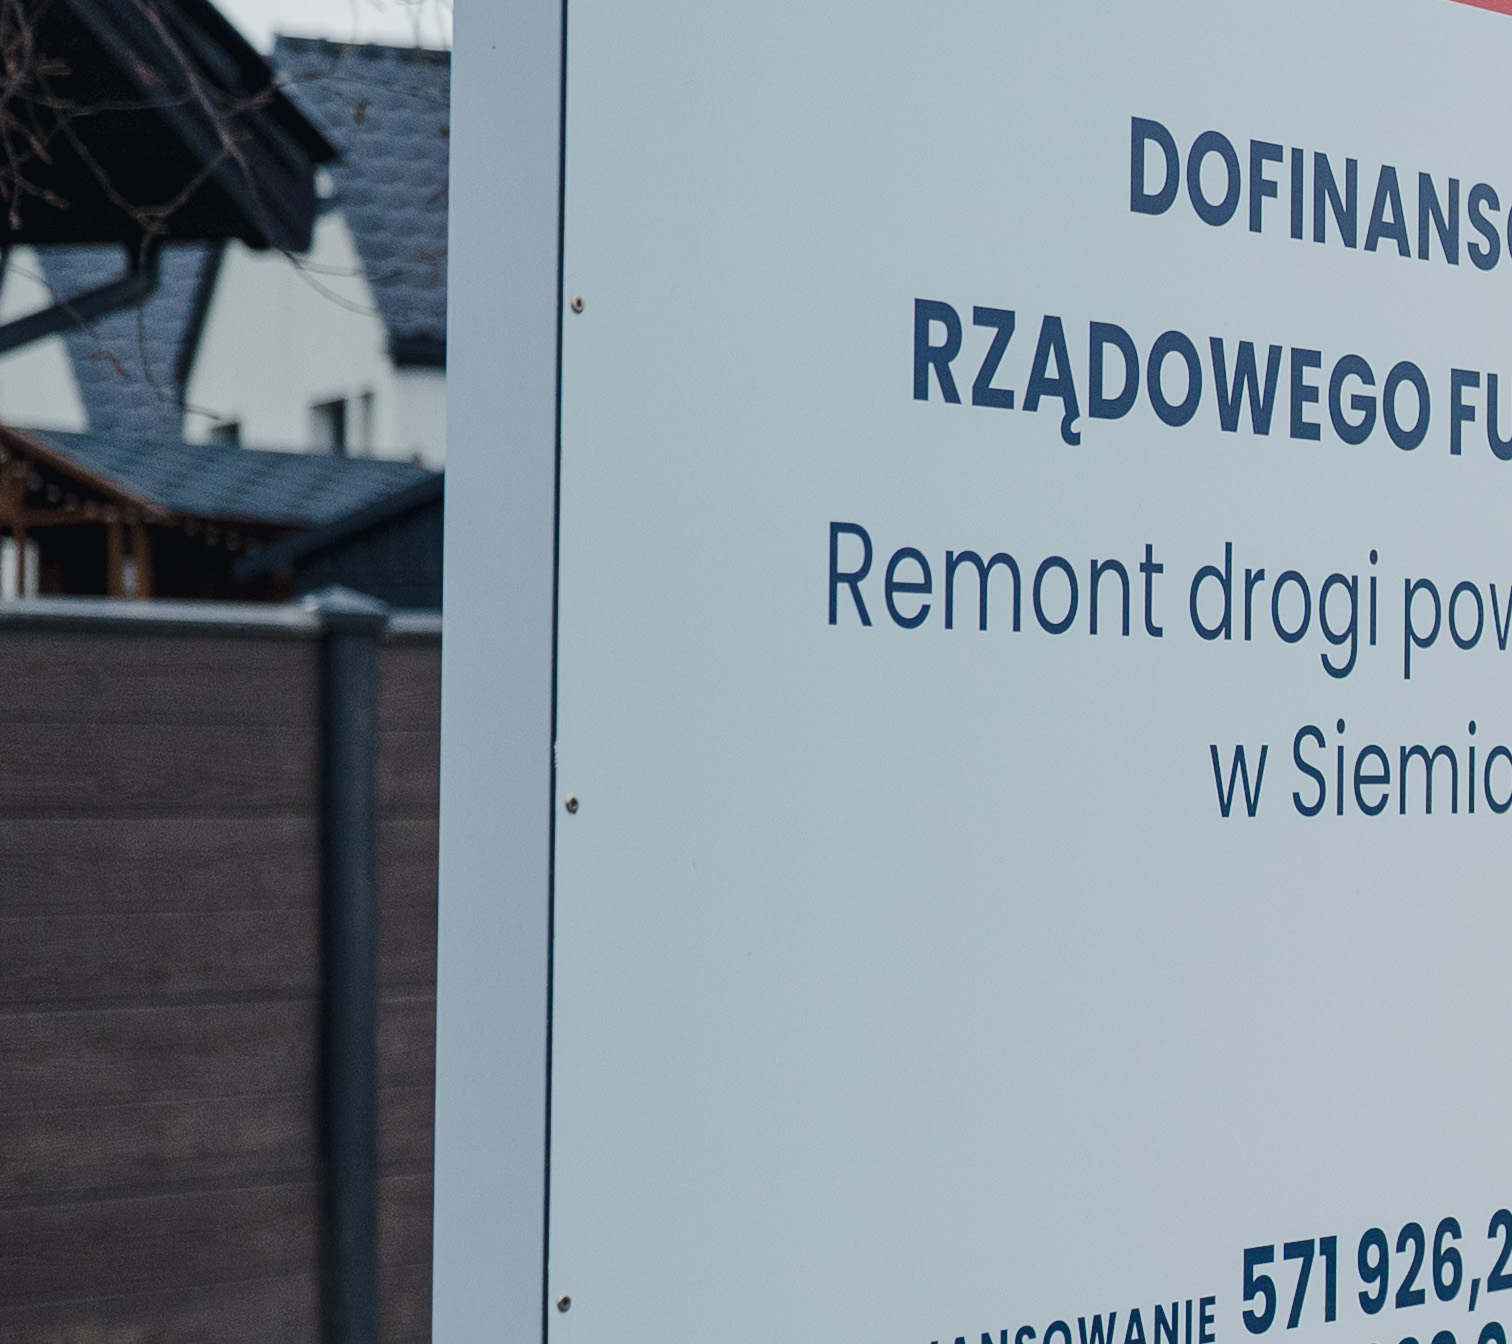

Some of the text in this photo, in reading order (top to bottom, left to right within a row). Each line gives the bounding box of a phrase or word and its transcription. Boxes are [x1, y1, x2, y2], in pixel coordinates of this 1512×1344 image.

[912, 297, 1432, 452] RZĄDOWEGO
[827, 520, 1165, 639] Remont
[1188, 541, 1379, 680] drogi
[1209, 743, 1269, 819] w
